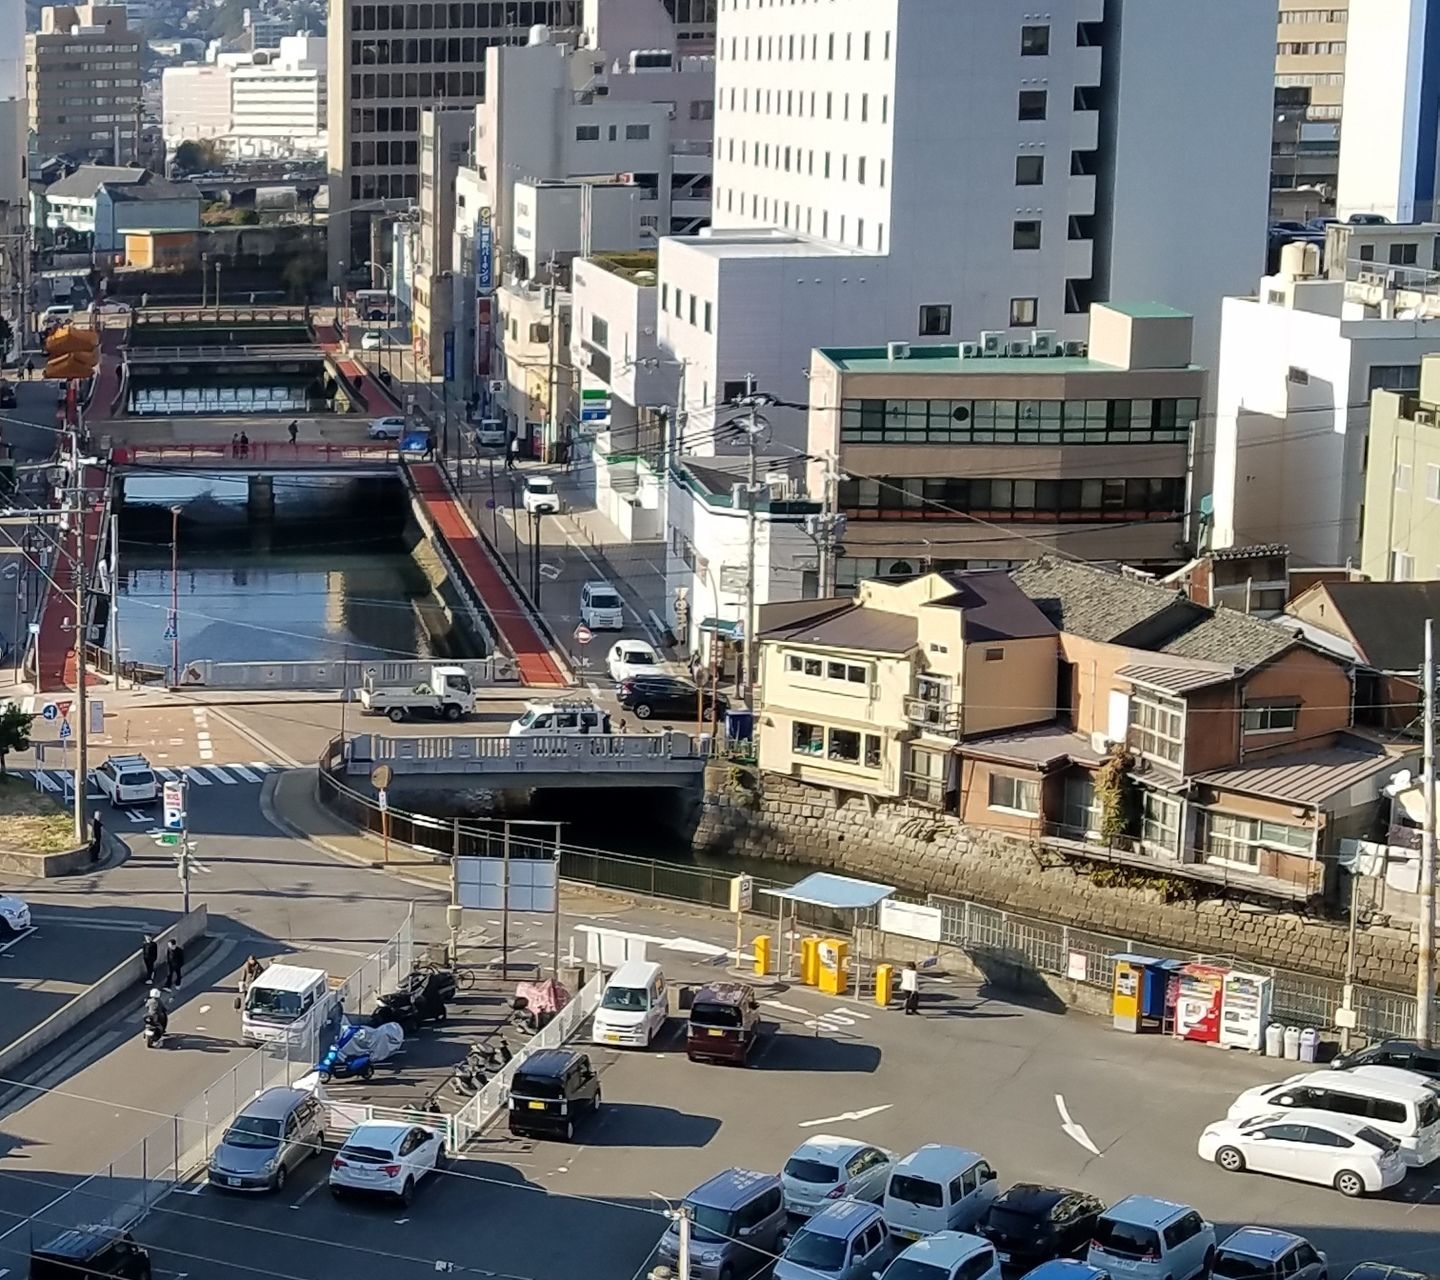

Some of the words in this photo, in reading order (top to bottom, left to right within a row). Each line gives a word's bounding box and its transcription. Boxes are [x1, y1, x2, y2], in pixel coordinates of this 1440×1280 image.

[481, 227, 490, 282] 町パーキング
